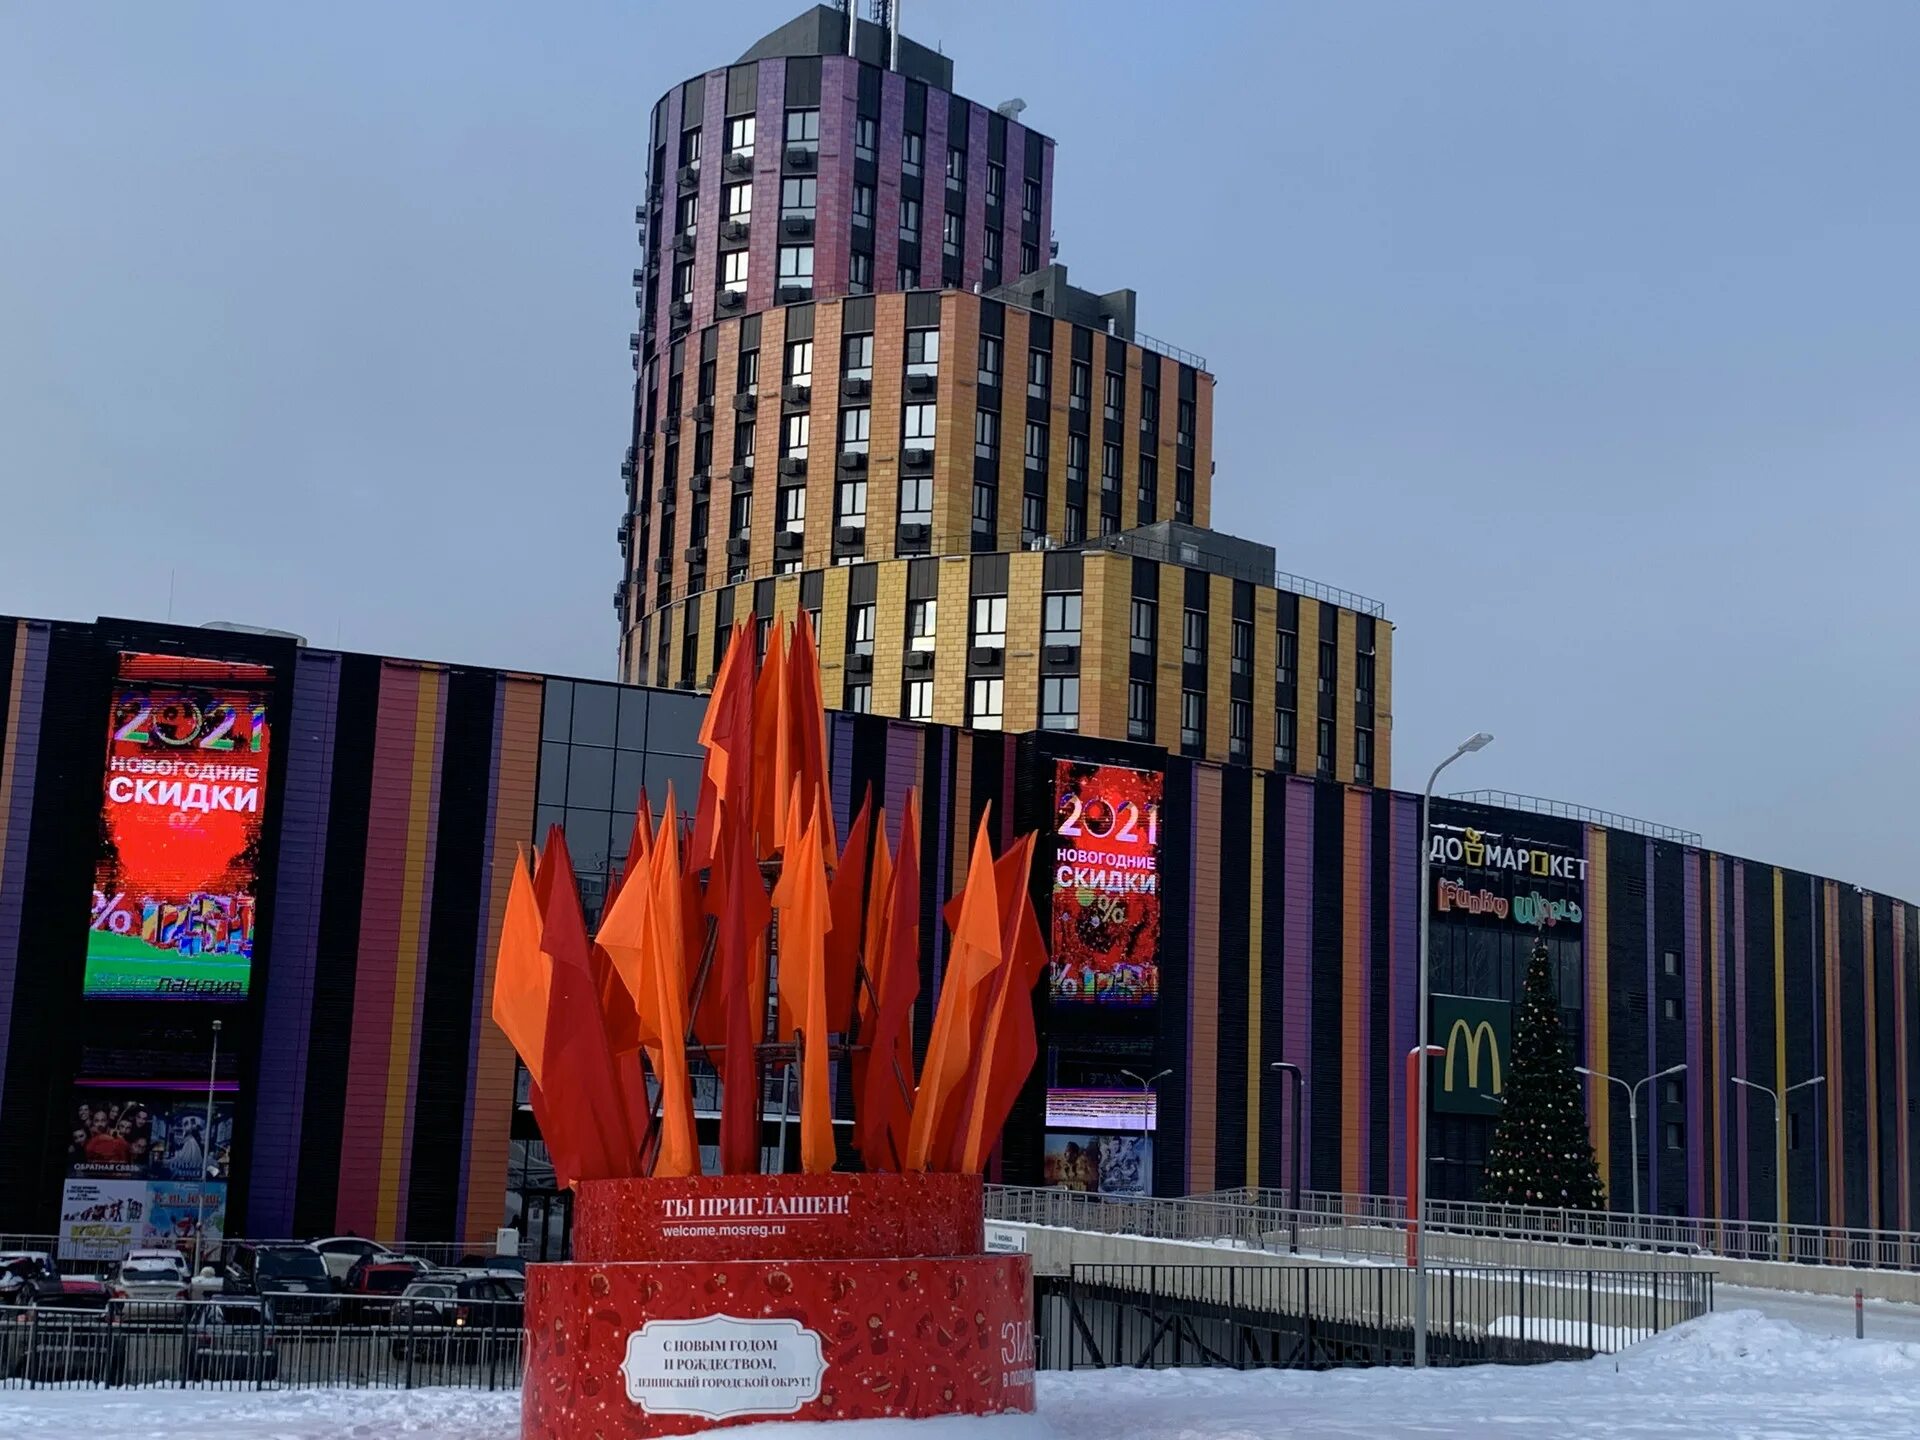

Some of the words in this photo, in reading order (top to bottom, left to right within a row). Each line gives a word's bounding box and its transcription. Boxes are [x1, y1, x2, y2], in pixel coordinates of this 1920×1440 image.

[114, 692, 266, 752] 2021
[110, 756, 259, 782] НОВОГОДНИЕ
[109, 776, 258, 814] СКИДКИ
[1058, 793, 1157, 845] 2021
[1057, 848, 1156, 870] НОВОГОДНИЕ
[1057, 865, 1156, 896] СКИДКИ
[1438, 877, 1509, 919] Funky
[662, 1198, 693, 1217] ТЫ
[662, 1224, 786, 1237] welcome.mosreg.ru
[663, 1340, 672, 1351] С
[674, 1340, 726, 1351] НОВЫМ
[730, 1339, 778, 1353] ГОДОМ
[664, 1359, 673, 1370] И
[677, 1358, 777, 1371] РОЖДЕСТВОМ,
[702, 1375, 769, 1388] ГОРОДСКОЙ
[772, 1376, 811, 1387] ОКРУГ!
